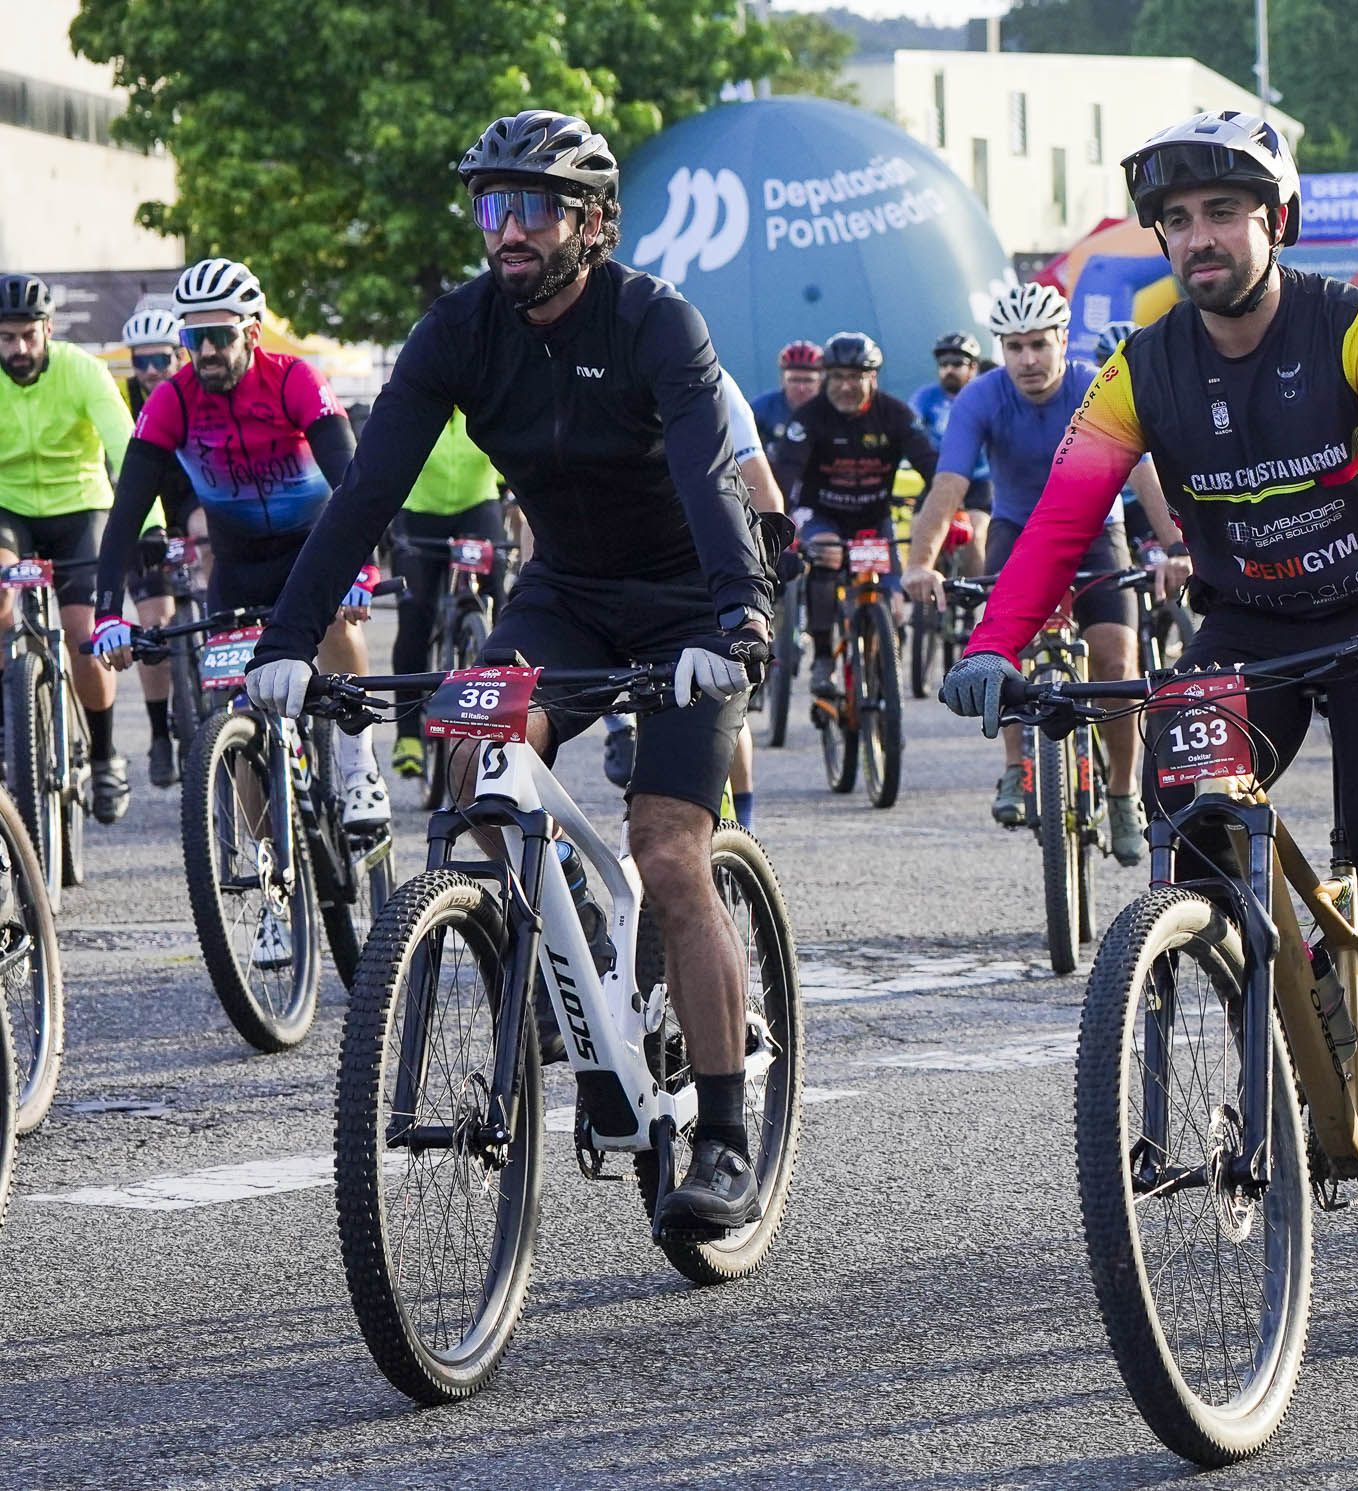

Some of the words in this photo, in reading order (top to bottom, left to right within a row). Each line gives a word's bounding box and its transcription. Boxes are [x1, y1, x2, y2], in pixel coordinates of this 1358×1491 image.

[1190, 470, 1233, 493] CLUB
[1289, 441, 1349, 477] NARÓN
[1255, 532, 1285, 549] GEAR
[1286, 511, 1344, 539] SOLUTIONS
[458, 688, 500, 710] 36
[1169, 718, 1228, 753] 133
[545, 943, 600, 1066] SCOTT
[1309, 987, 1348, 1091] ORBEA
